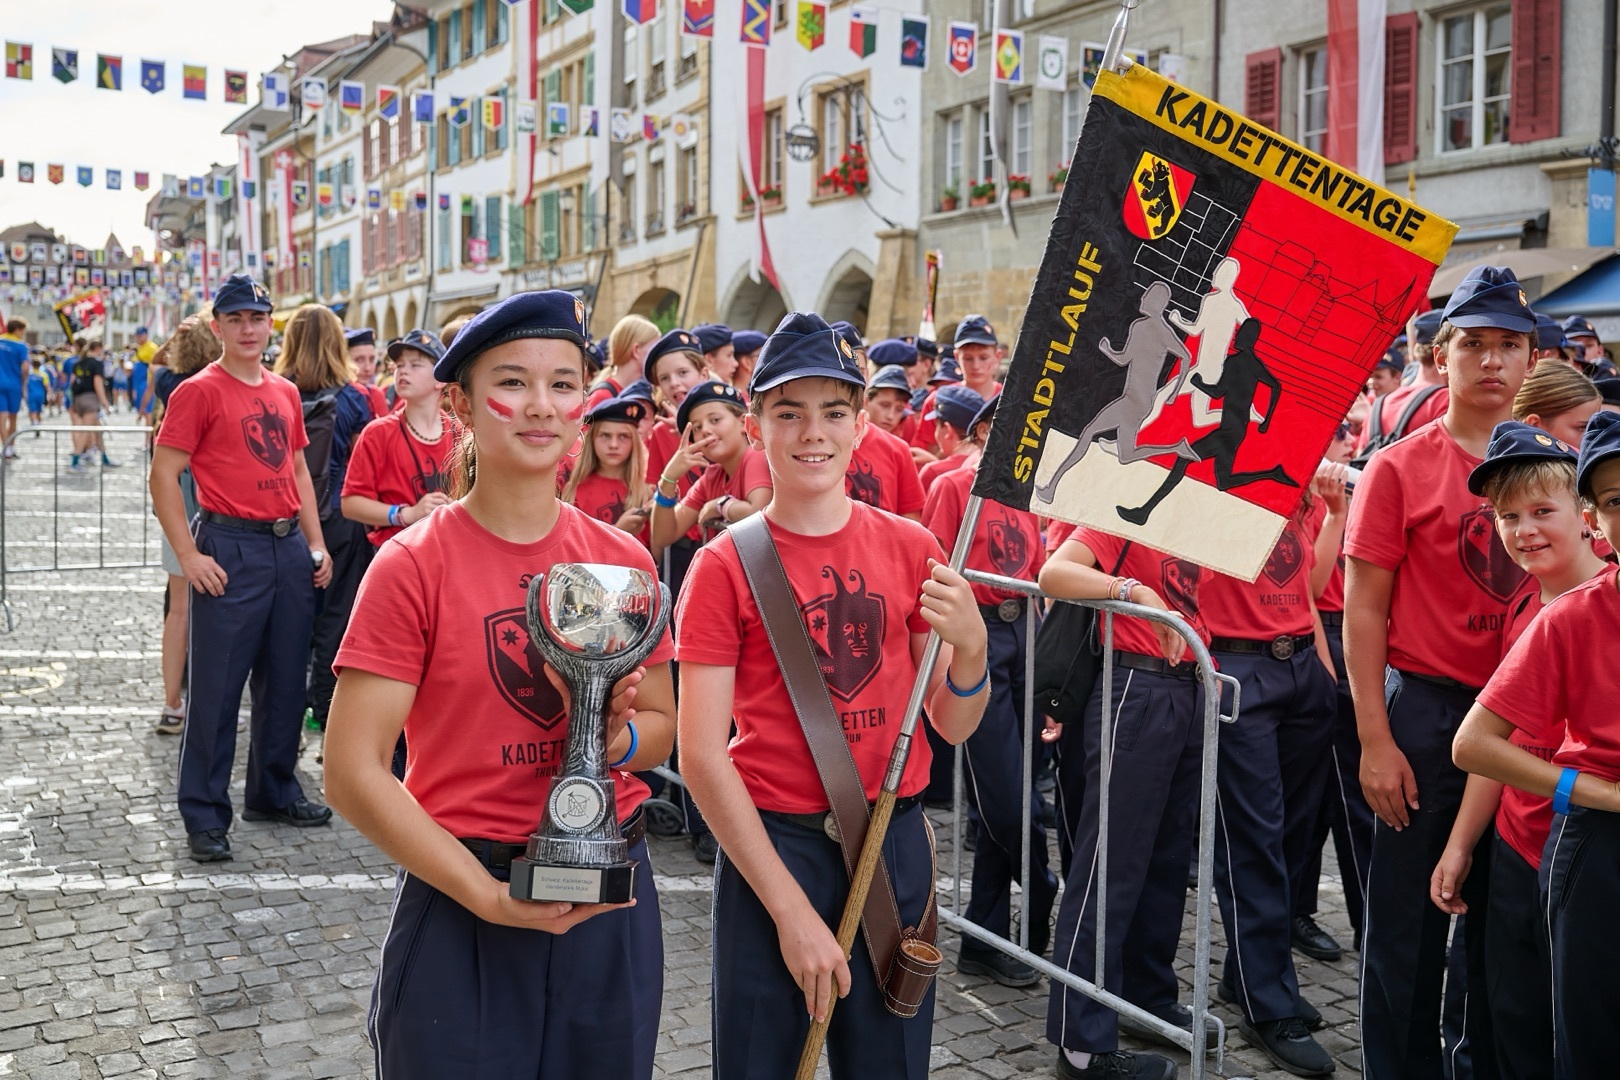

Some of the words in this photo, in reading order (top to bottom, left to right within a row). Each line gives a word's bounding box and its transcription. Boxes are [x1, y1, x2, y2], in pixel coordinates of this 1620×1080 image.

[1155, 84, 1427, 243] KADETTENTAGE
[1013, 241, 1103, 484] STADTLAUF
[1260, 593, 1300, 606] KADETTEN
[517, 687, 534, 697] 1839
[841, 707, 885, 730] ETTEN
[534, 764, 558, 778] THUN
